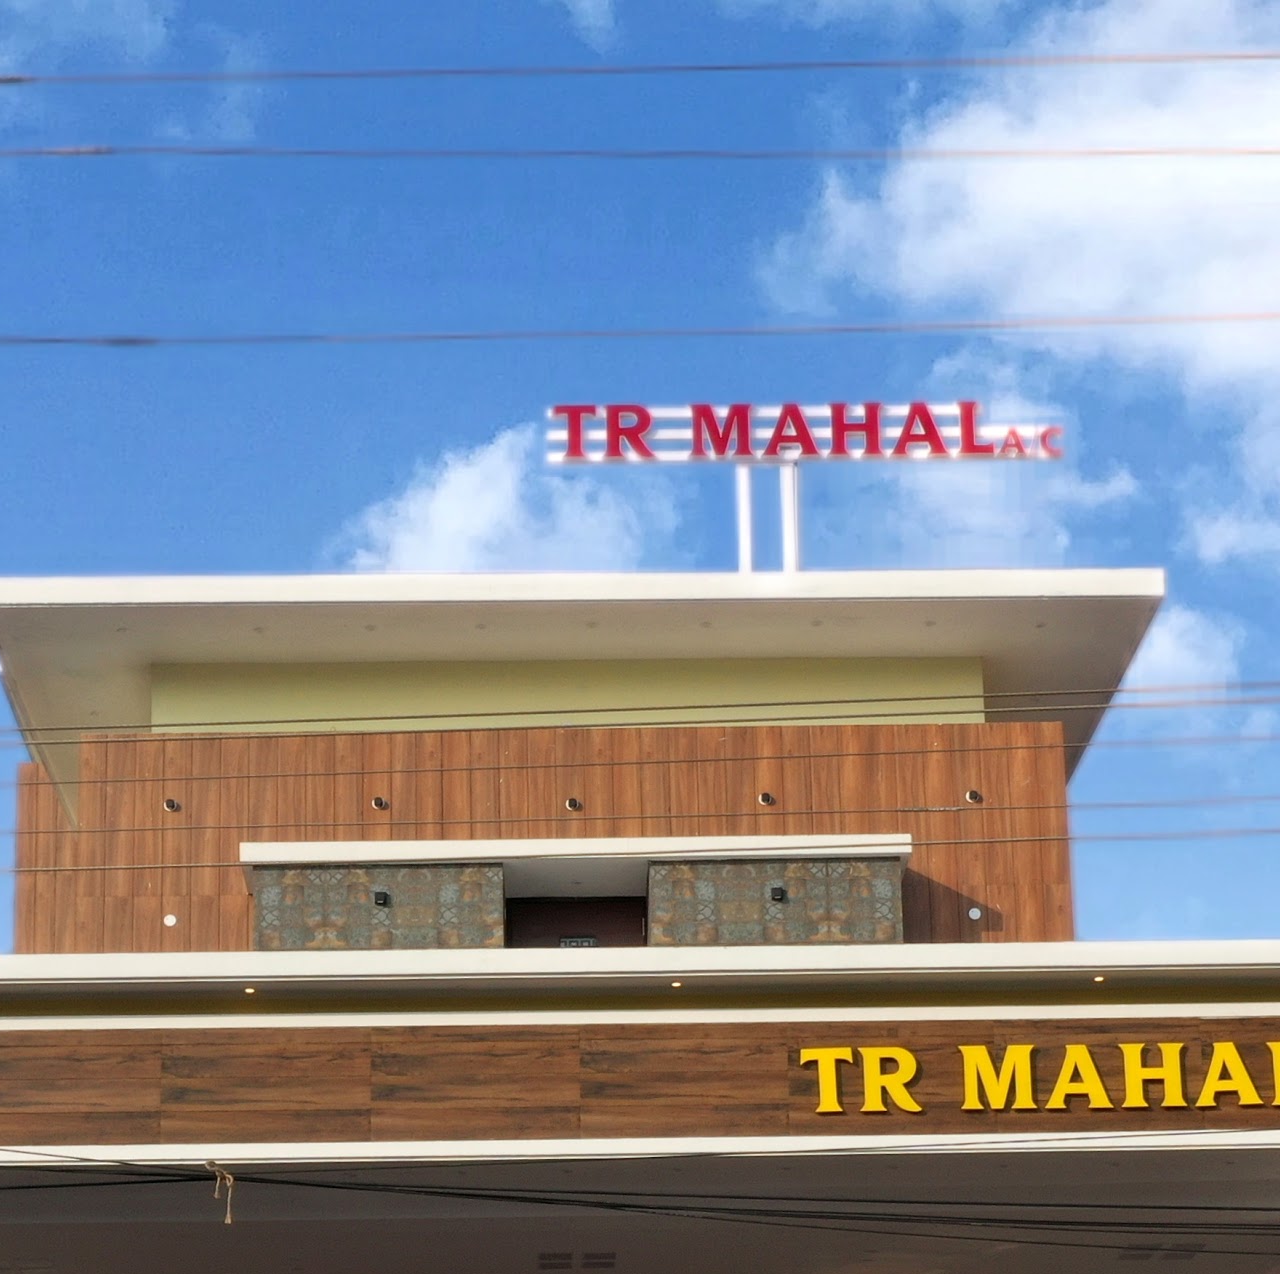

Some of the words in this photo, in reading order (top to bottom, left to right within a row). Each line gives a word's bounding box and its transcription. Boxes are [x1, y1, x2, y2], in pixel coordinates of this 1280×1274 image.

[554, 404, 654, 458] TR
[690, 400, 995, 457] MAHAL
[800, 1047, 922, 1112] TR
